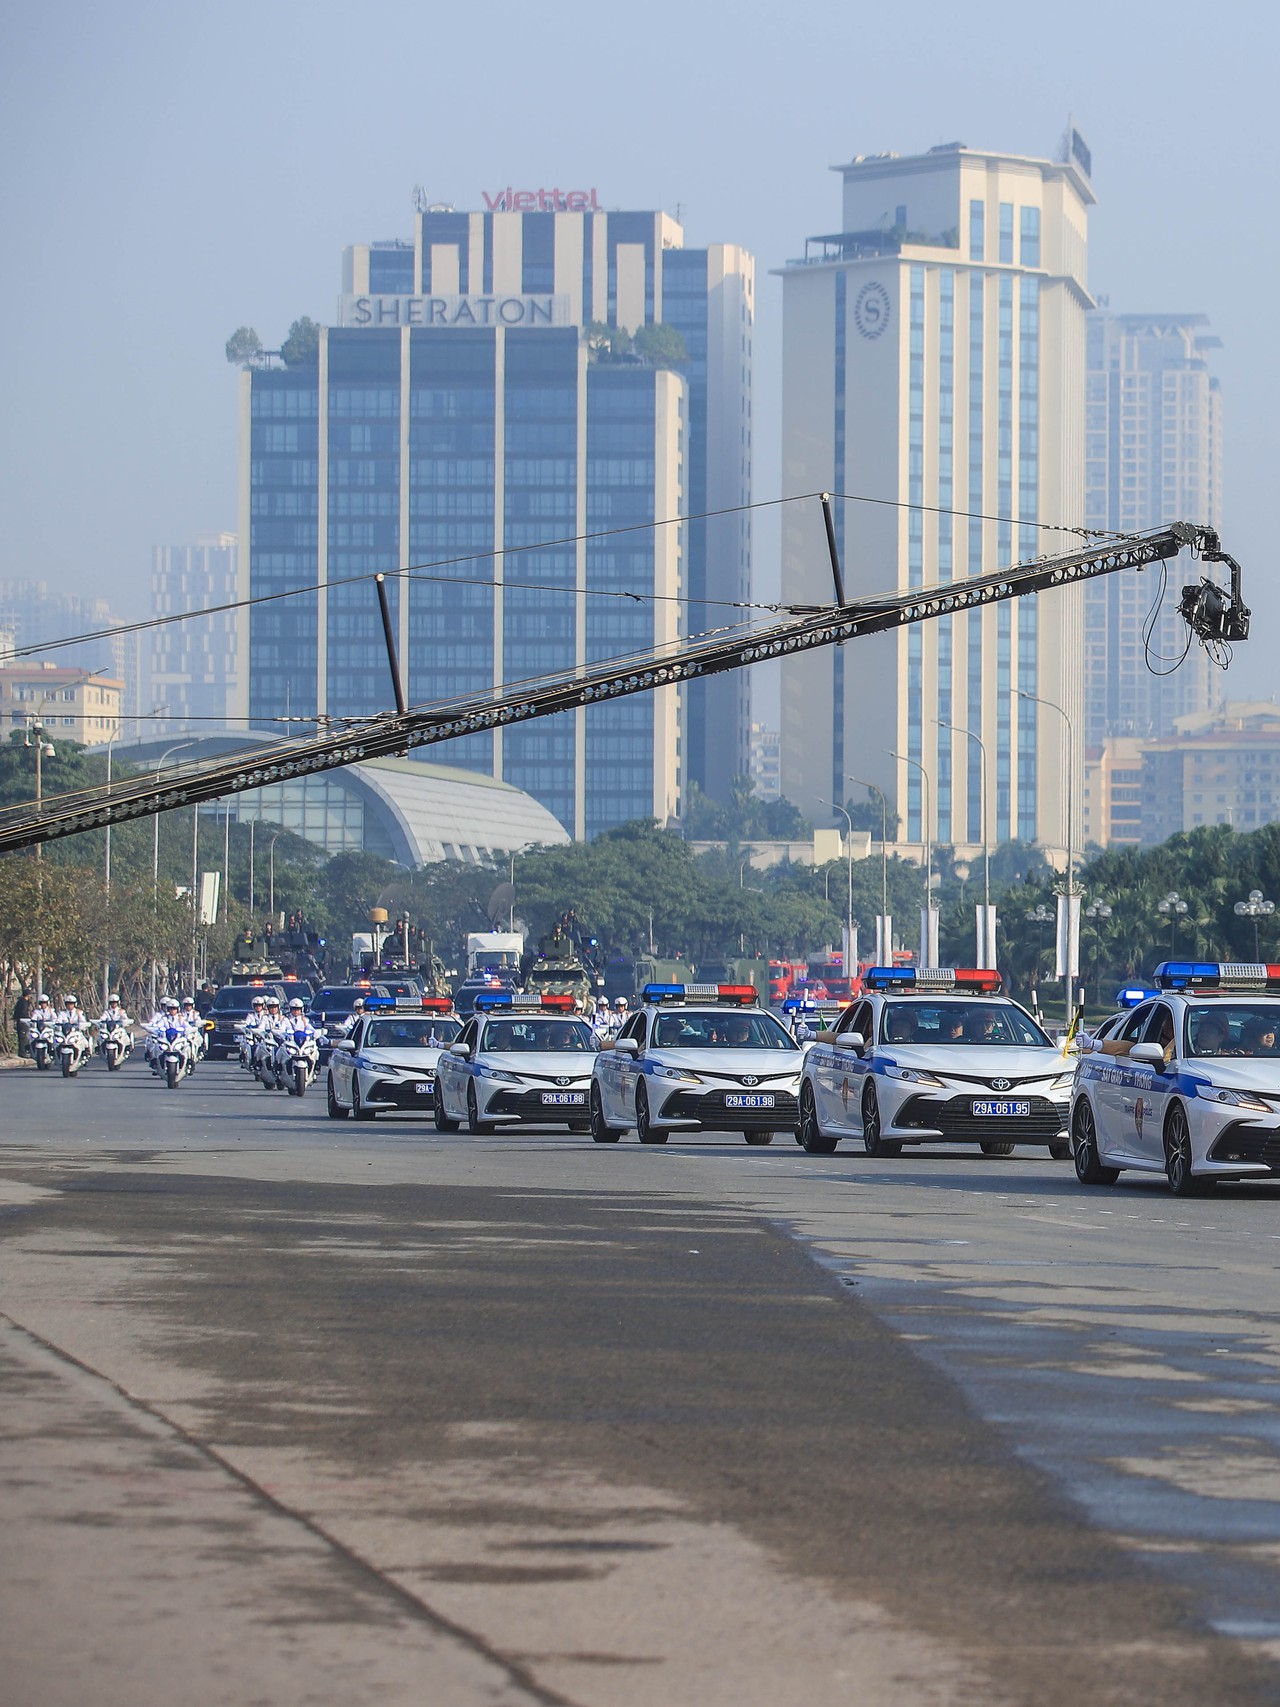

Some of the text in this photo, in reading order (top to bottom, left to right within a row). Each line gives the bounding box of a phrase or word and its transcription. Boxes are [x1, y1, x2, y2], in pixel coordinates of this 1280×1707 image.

[481, 186, 602, 212] viettel
[354, 298, 553, 325] SHERATON
[727, 1095, 774, 1107] 29A-061.98
[974, 1102, 1029, 1115] 29A-061.95
